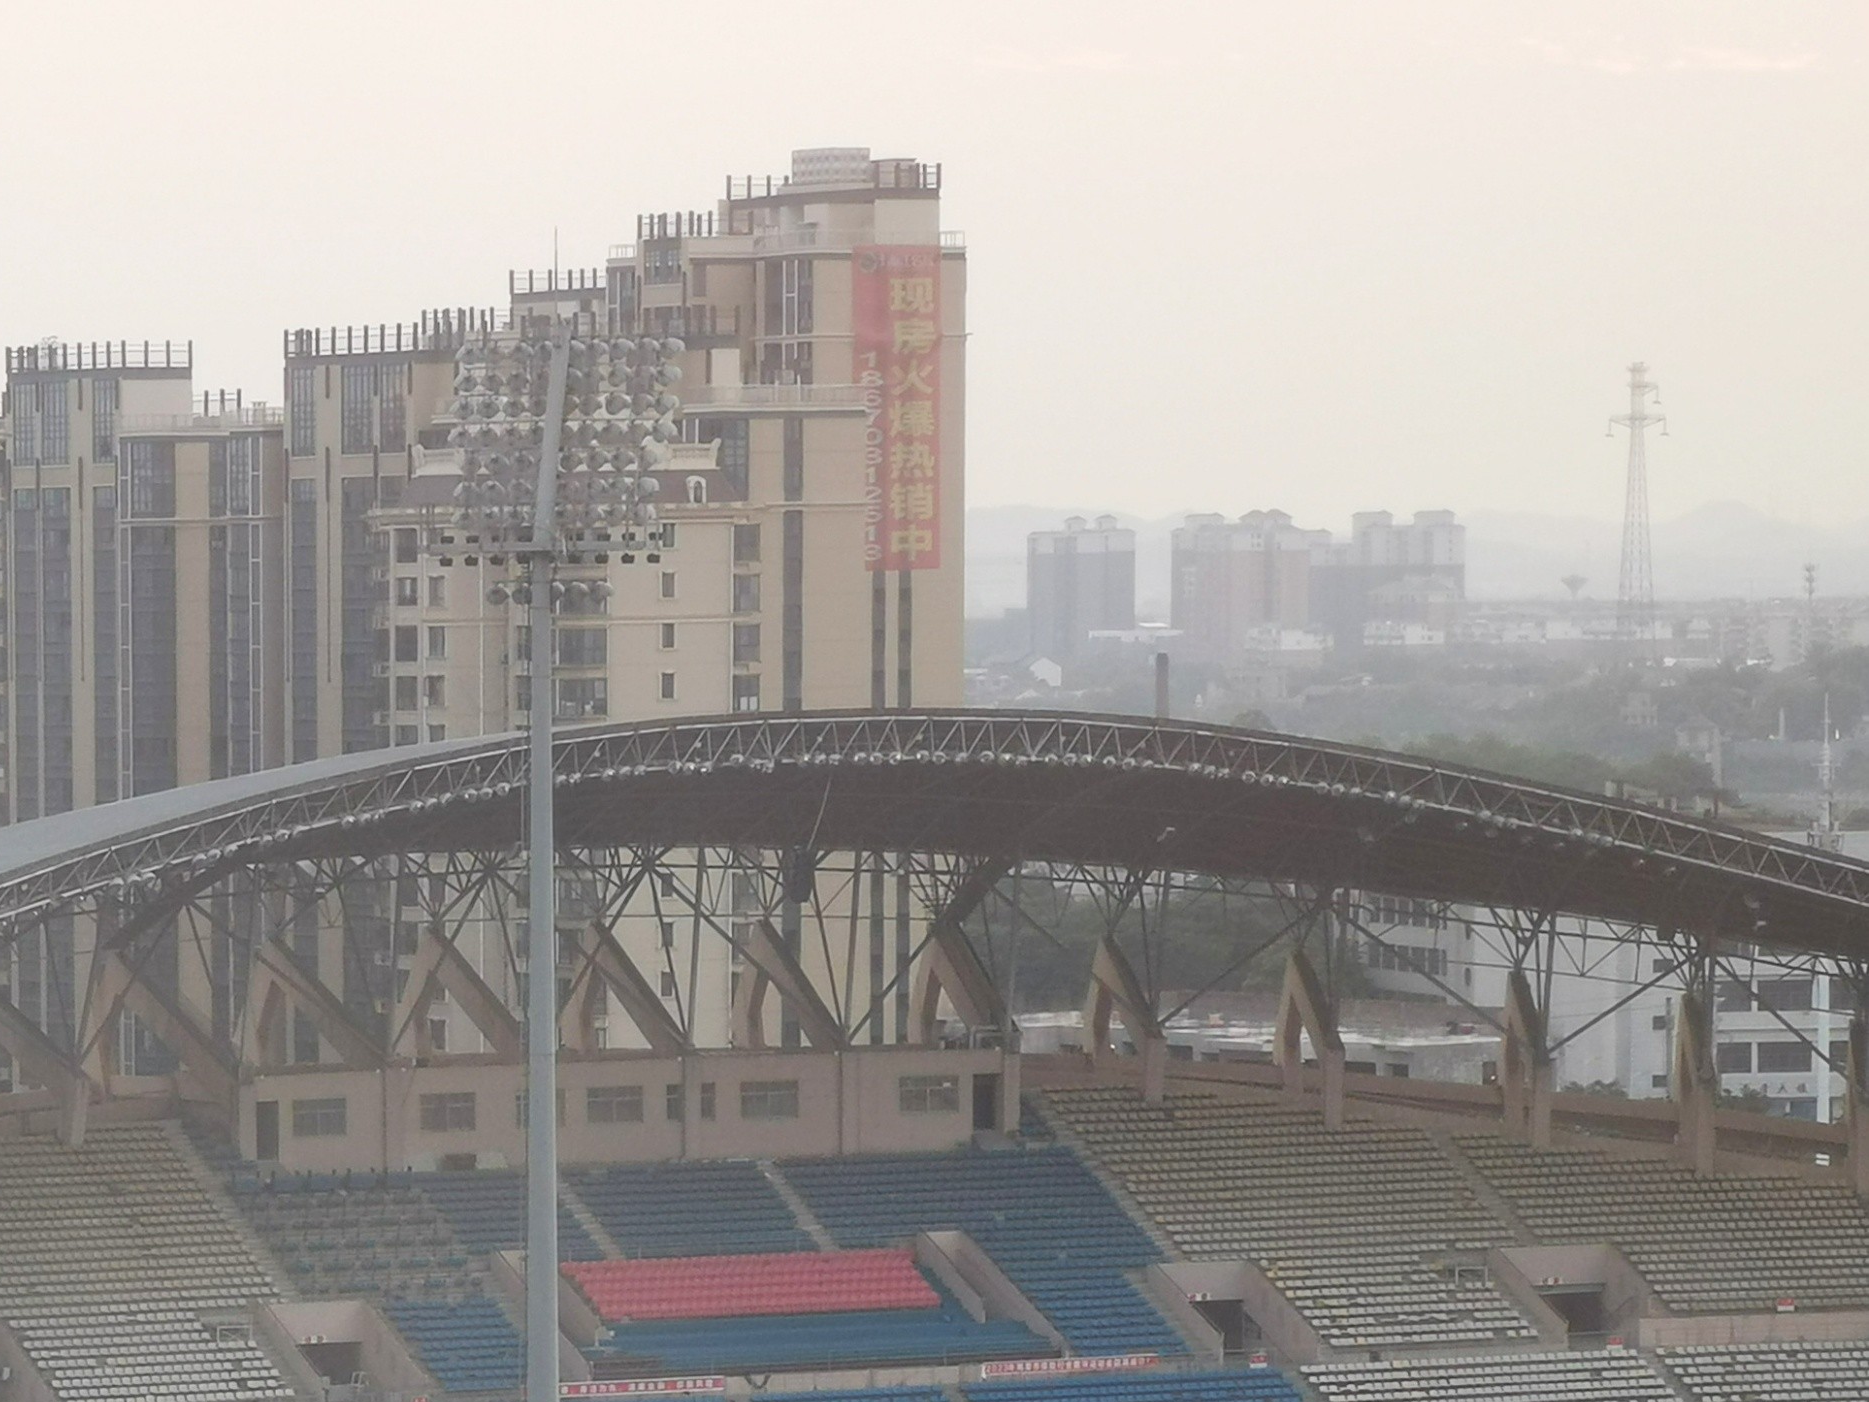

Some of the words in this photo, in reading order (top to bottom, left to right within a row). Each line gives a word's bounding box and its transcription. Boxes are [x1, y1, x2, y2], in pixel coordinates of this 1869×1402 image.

[890, 278, 935, 561] 现房火爆热销中
